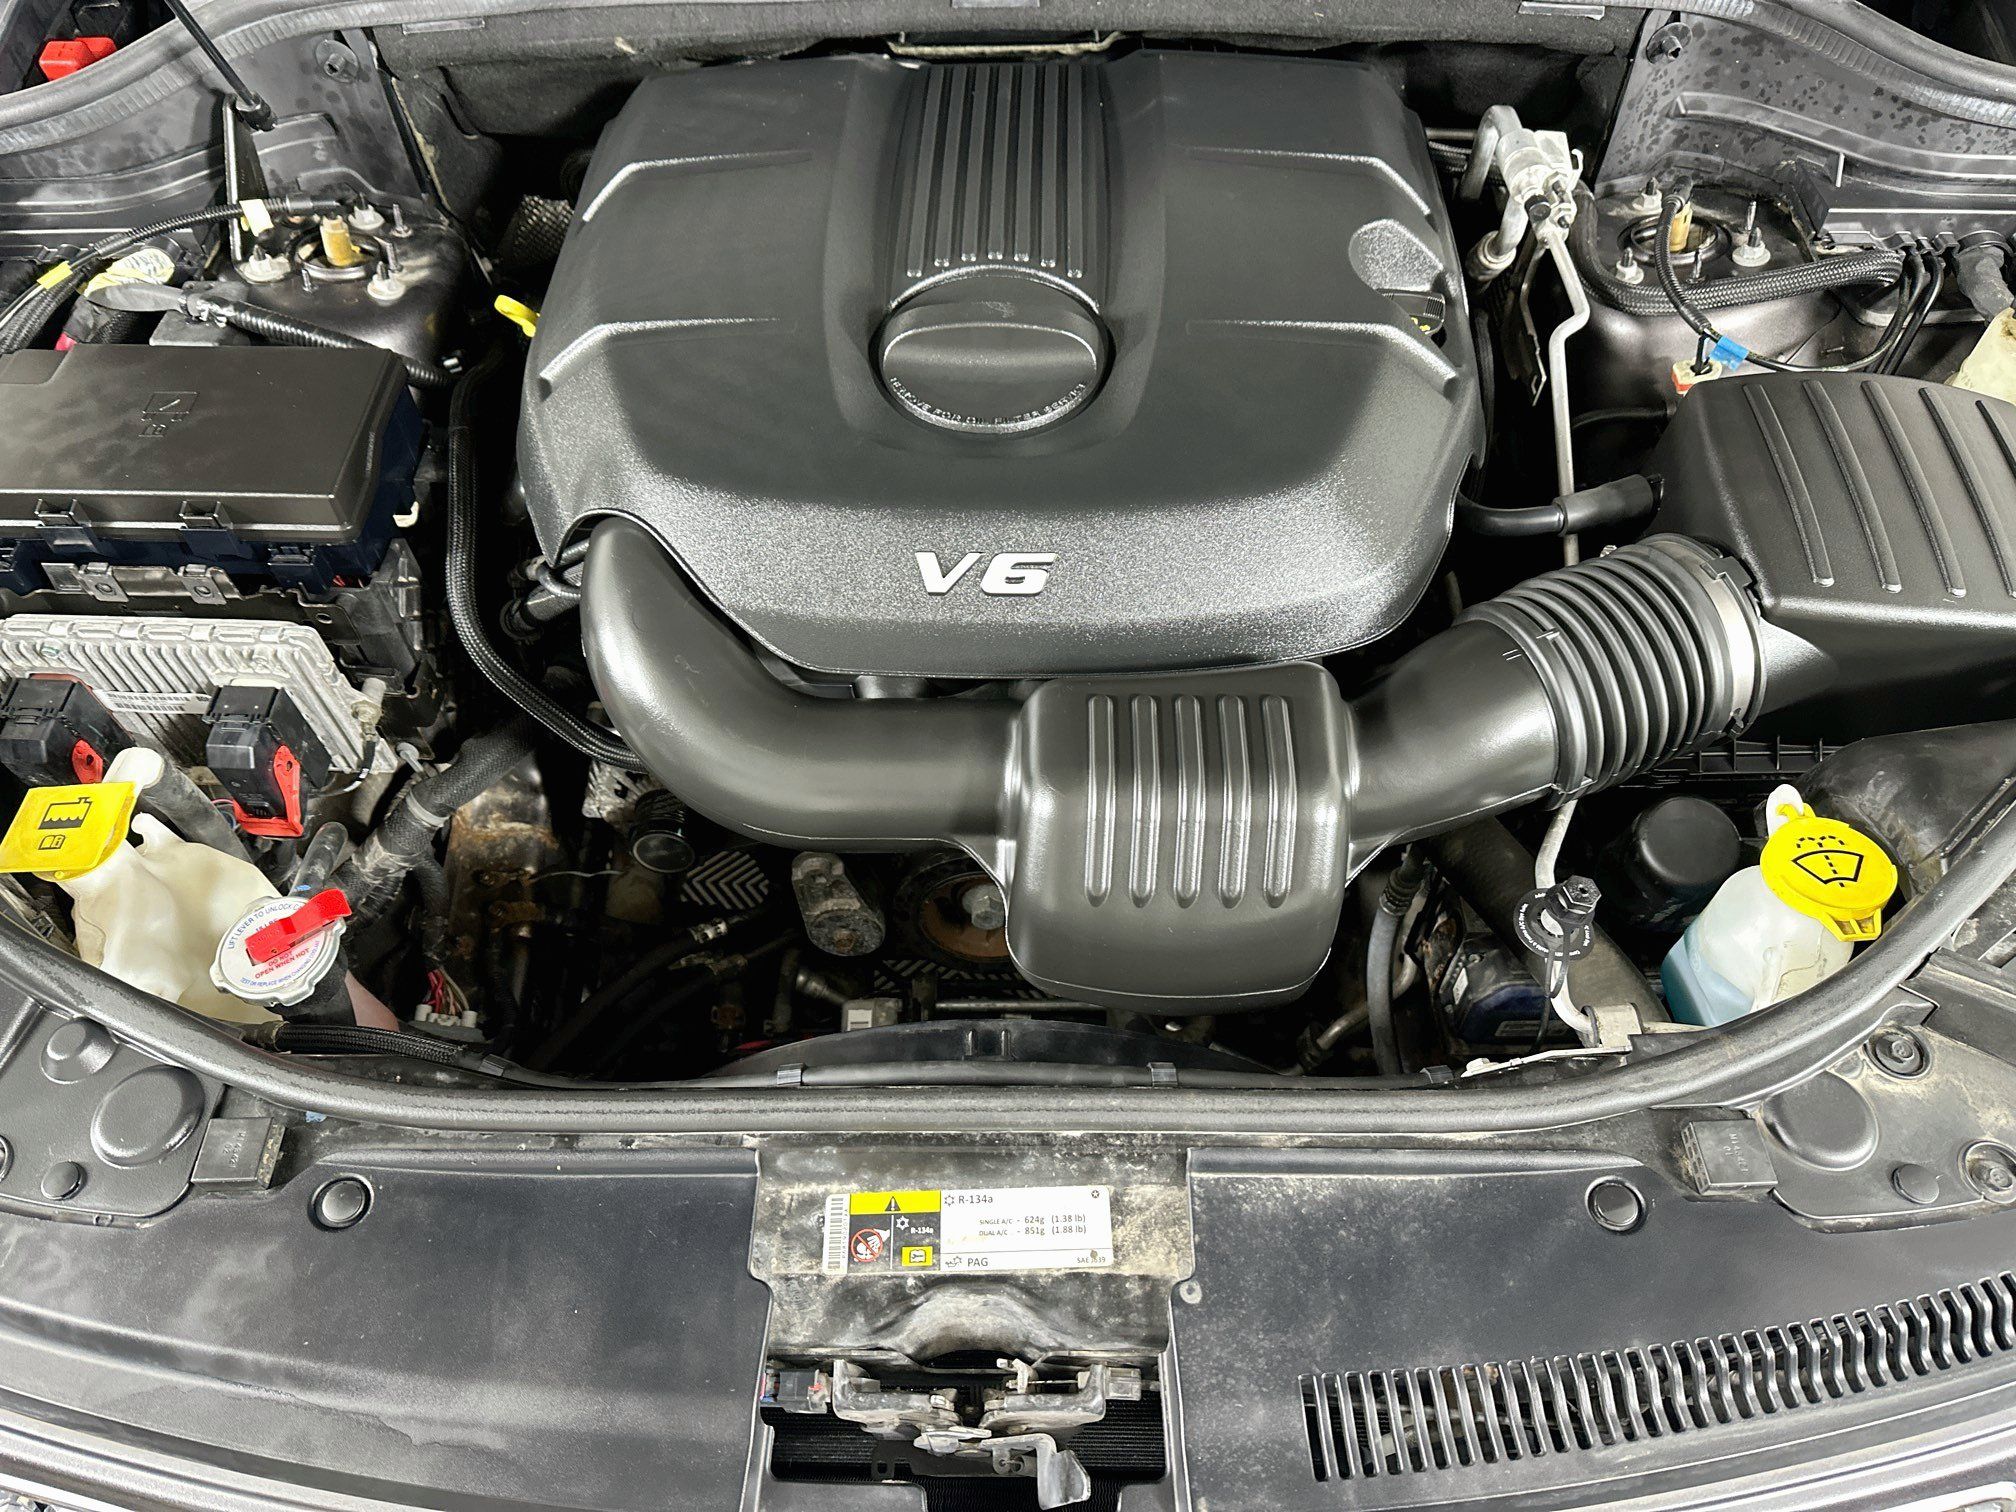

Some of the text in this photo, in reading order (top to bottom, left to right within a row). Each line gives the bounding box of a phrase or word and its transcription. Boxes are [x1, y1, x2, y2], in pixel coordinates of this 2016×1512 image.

[933, 408, 962, 422] FOR
[914, 551, 1061, 596] V6
[235, 917, 254, 936] LEVER
[254, 910, 265, 920] TO
[265, 903, 292, 915] UNLOCK
[254, 947, 310, 979] OPEN WHEN HOT
[268, 950, 293, 967] DO NOT
[958, 1194, 993, 1204] R-134a
[1024, 1215, 1045, 1225] 624g
[1051, 1214, 1073, 1225] (1.38
[1074, 1213, 1086, 1223] lb)
[1024, 1226, 1045, 1236] 851g
[1051, 1225, 1074, 1235] (1.88
[1075, 1224, 1087, 1235] lb)
[967, 1257, 989, 1267] PAG
[1076, 1256, 1090, 1264] SAE
